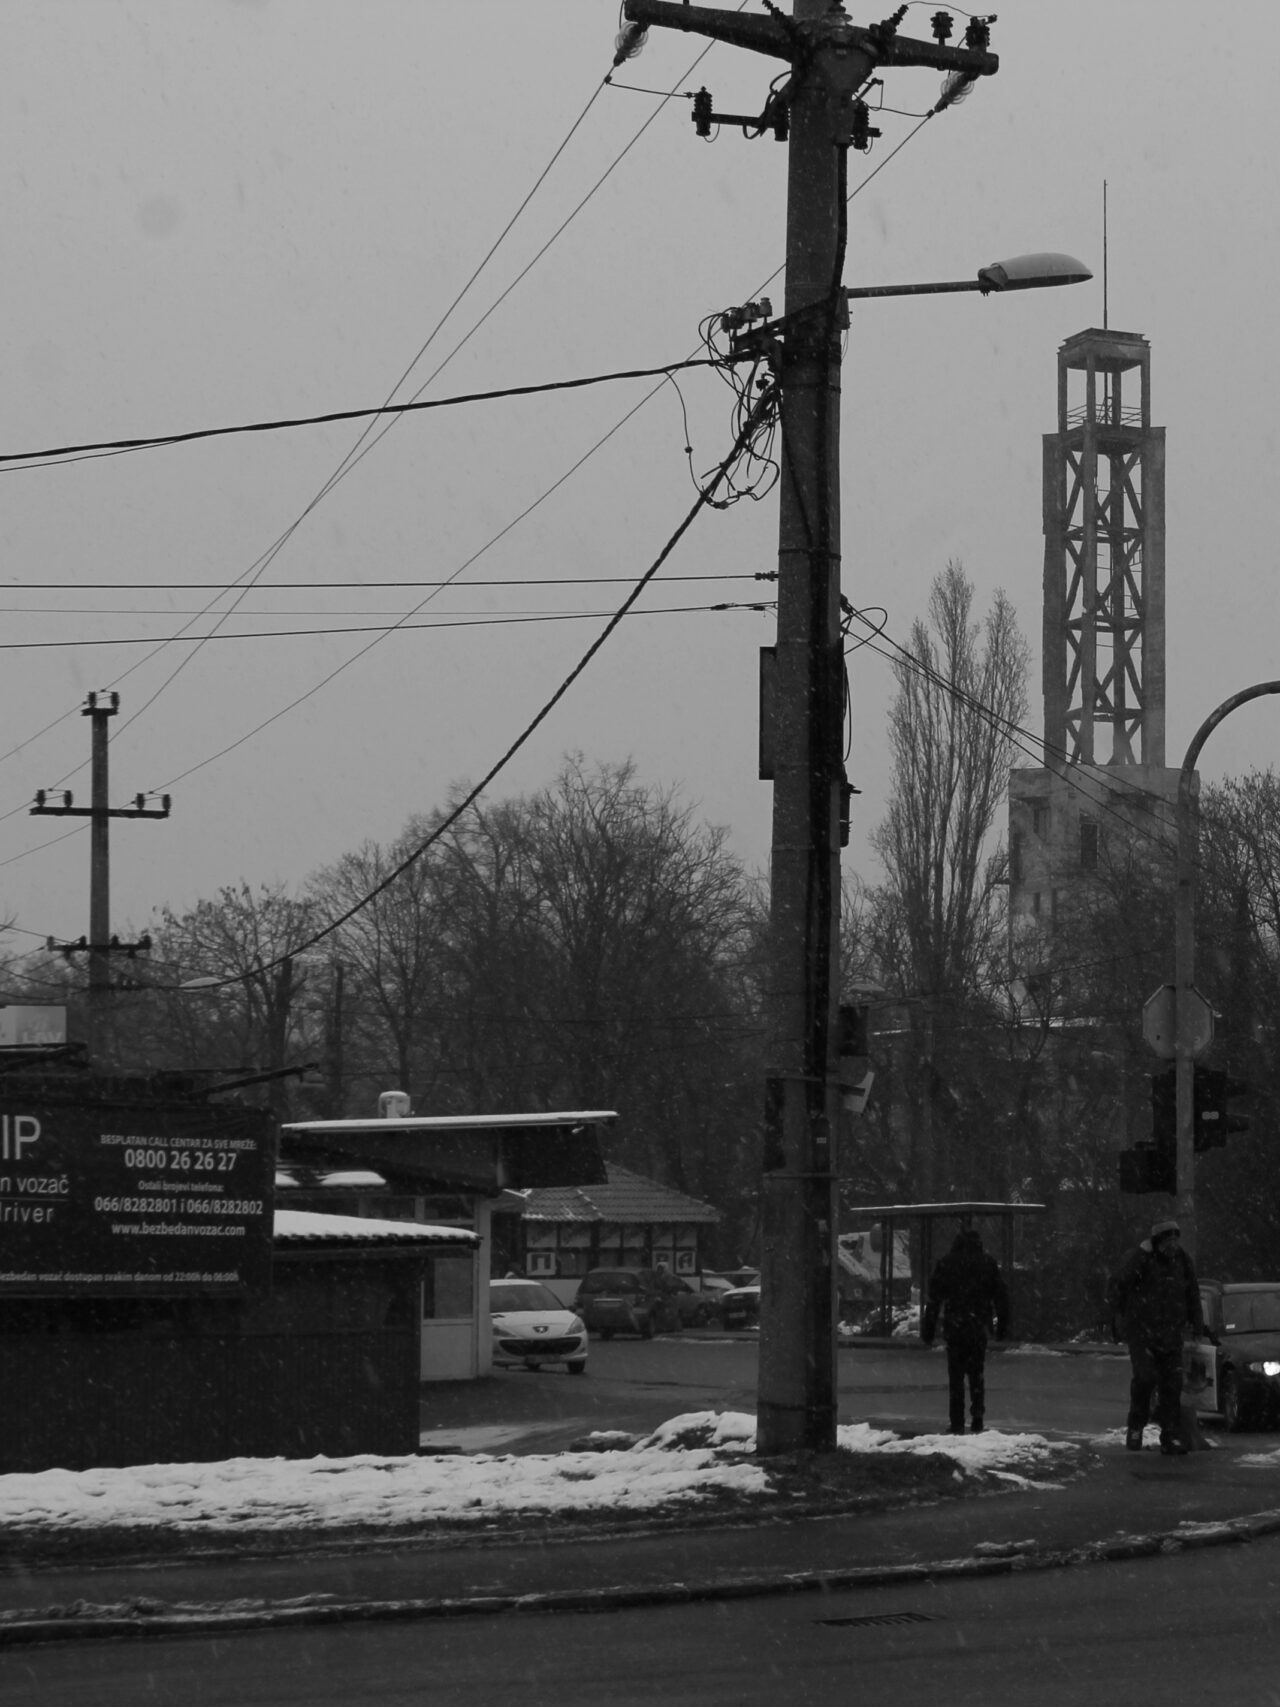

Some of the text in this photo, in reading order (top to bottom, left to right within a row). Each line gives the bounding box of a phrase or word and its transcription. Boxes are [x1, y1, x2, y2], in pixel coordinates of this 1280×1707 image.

[2, 1114, 41, 1160] IP
[101, 1134, 147, 1145] BESPLATAN
[148, 1136, 169, 1147] CALL
[170, 1137, 201, 1148] CENTAR
[202, 1139, 213, 1149] ZA
[214, 1139, 229, 1150] SVE
[125, 1149, 237, 1171] 0800 26 26 27
[16, 1174, 70, 1194] vozač
[94, 1196, 263, 1215] 066/8282801 i 066/8282802
[112, 1221, 246, 1236] www.bezbedanvozac.com
